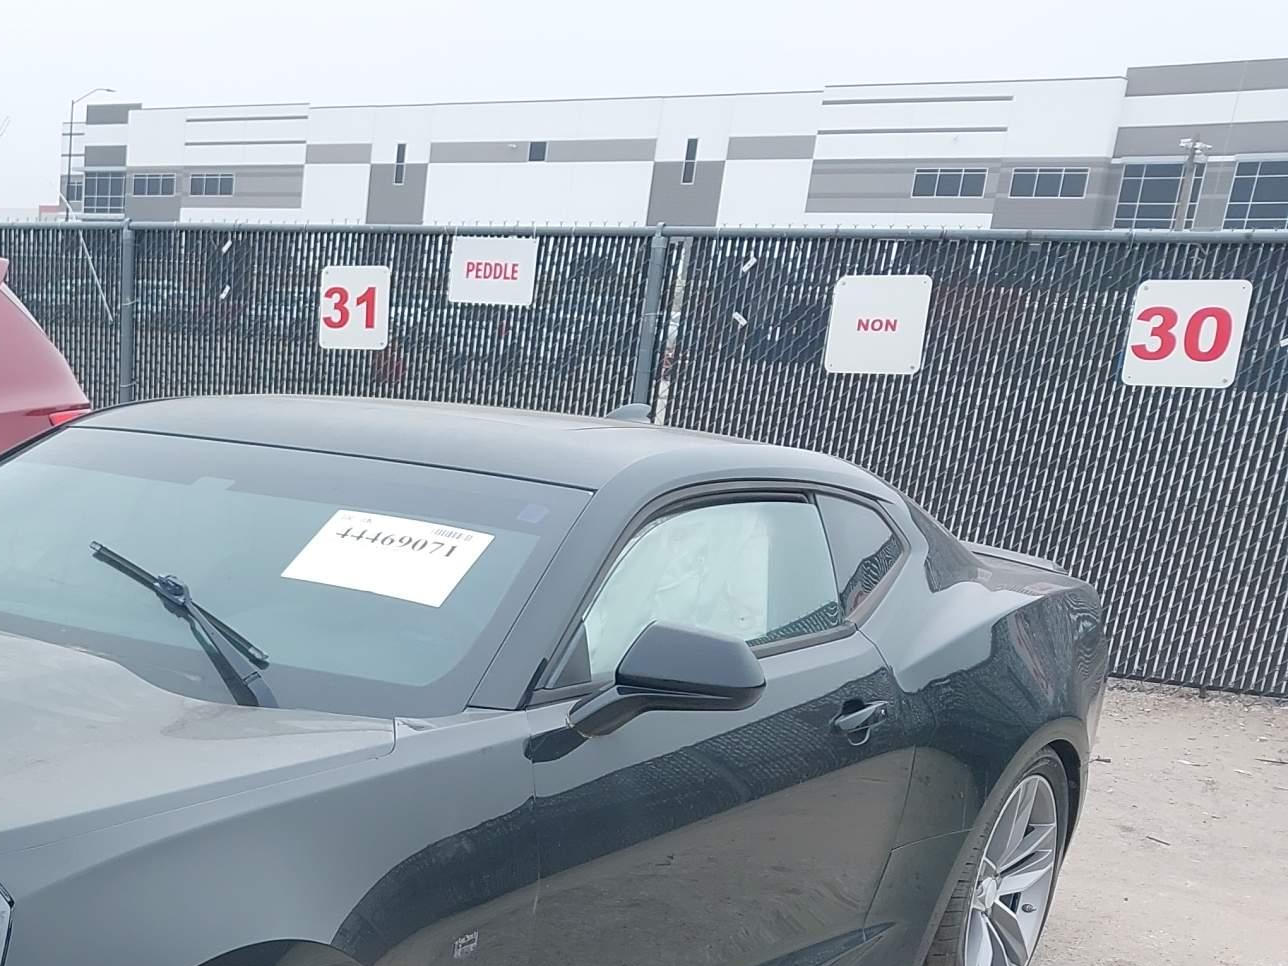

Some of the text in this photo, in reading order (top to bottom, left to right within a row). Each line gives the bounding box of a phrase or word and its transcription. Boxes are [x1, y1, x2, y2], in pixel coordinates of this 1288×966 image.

[465, 261, 519, 281] PEDDLE
[322, 286, 377, 330] 31
[856, 319, 899, 333] NON
[1130, 305, 1234, 363] 30
[335, 527, 458, 558] 44469071
